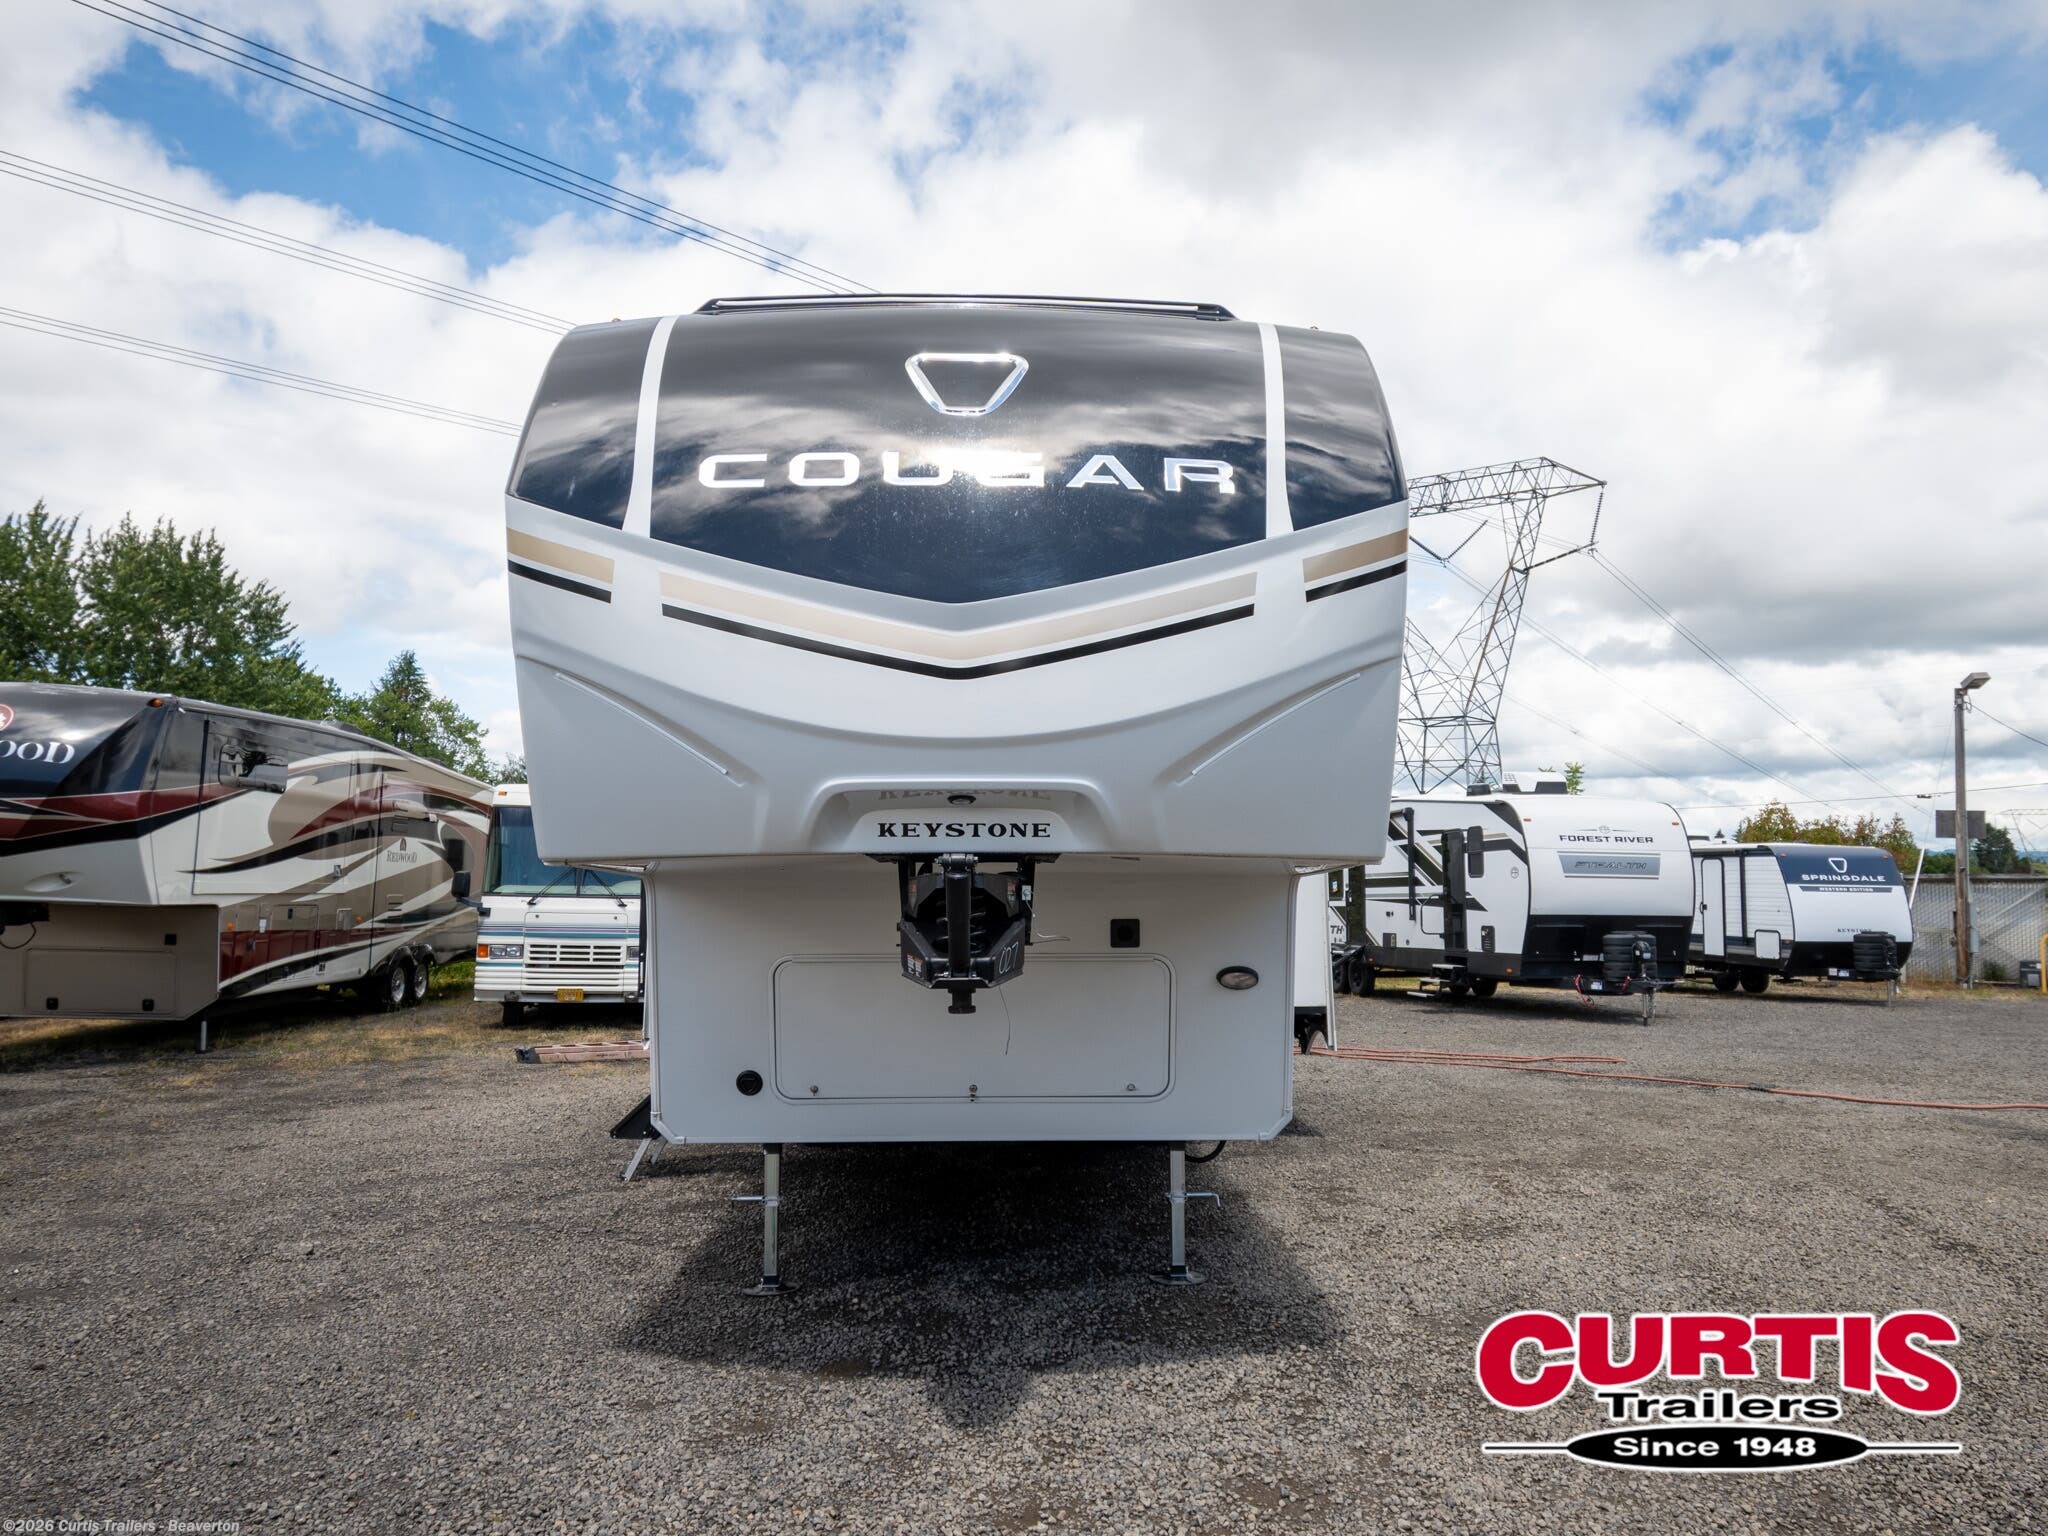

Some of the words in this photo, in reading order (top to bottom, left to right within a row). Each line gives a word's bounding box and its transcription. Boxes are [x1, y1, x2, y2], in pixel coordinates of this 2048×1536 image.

[698, 449, 1236, 495] COUGAR
[877, 822, 1051, 838] KEYSTONE
[1559, 834, 1611, 843] FOREST
[1614, 836, 1654, 844] RIVER
[1801, 873, 1887, 882] SPRINGDALE
